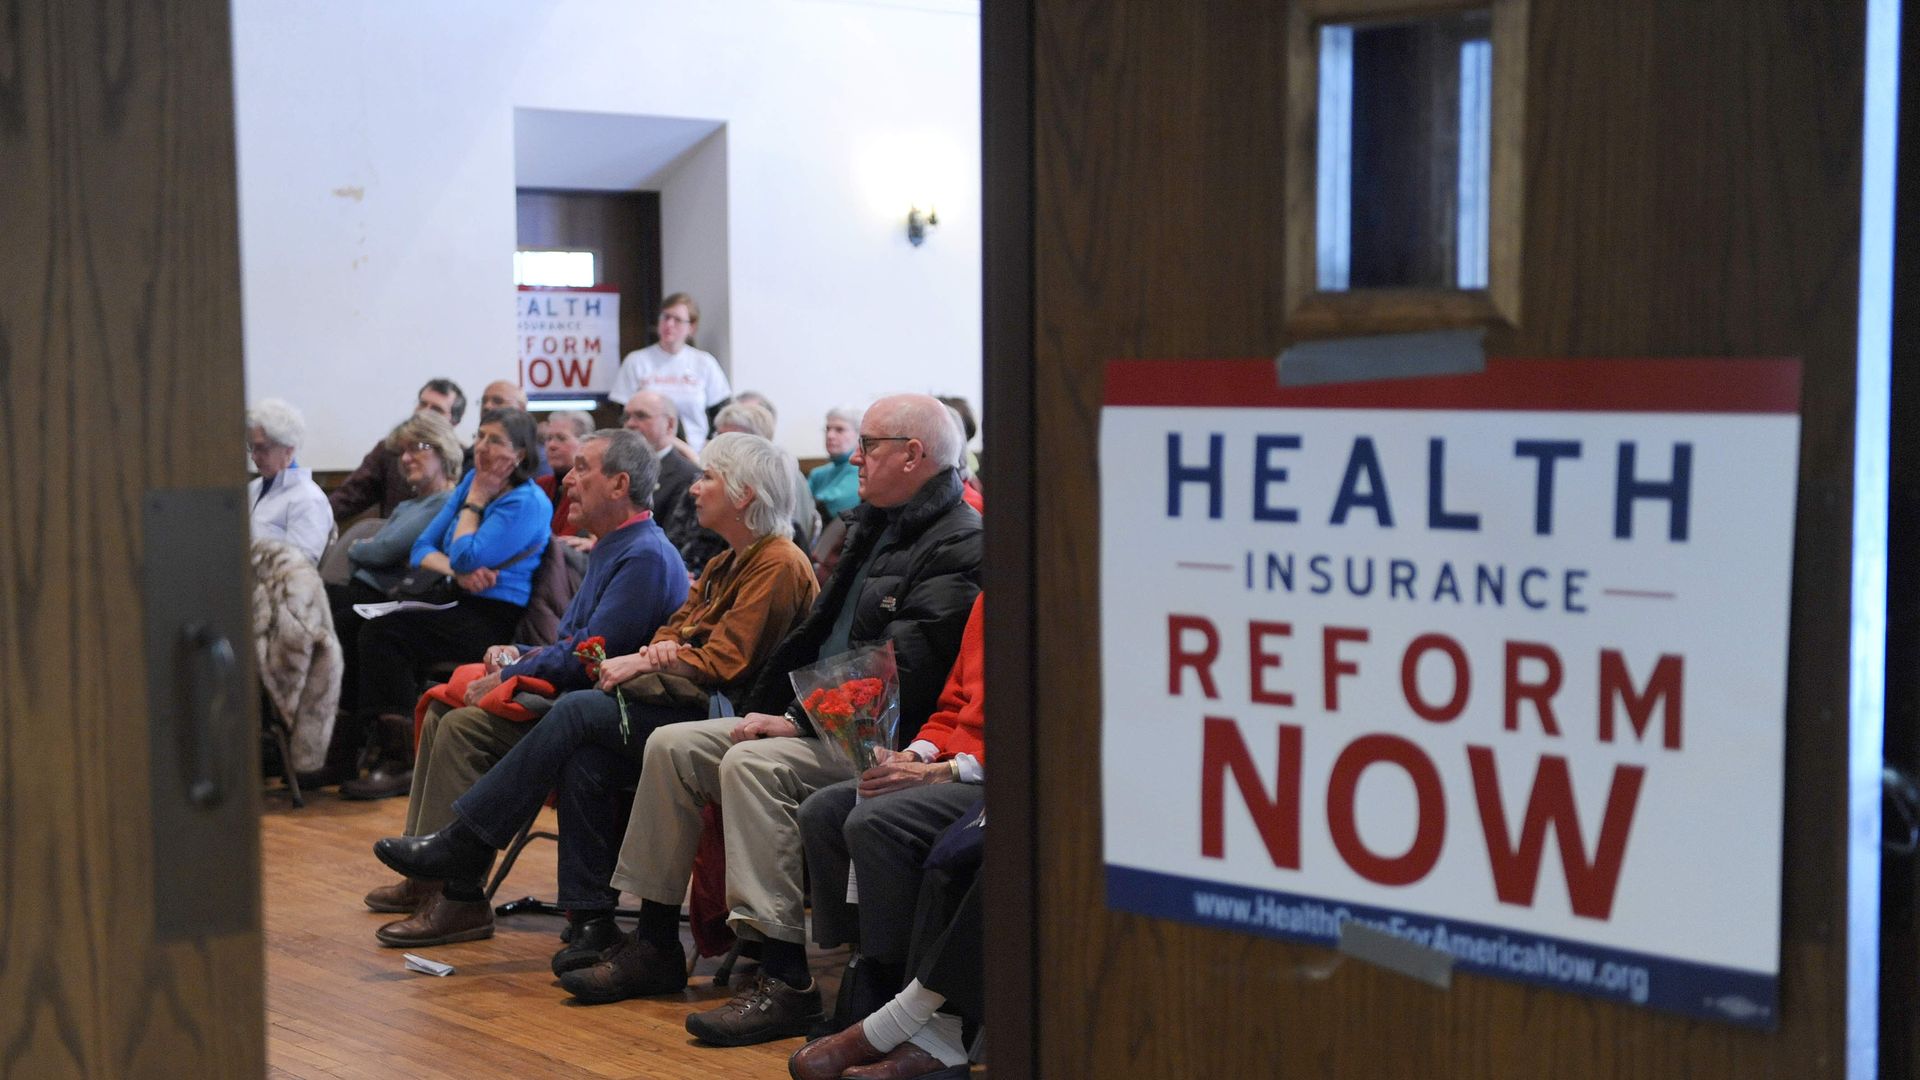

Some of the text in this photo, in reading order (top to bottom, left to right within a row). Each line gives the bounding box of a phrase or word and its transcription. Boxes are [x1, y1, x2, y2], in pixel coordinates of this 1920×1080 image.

[518, 336, 601, 354] FORM
[518, 358, 593, 388] OW
[1165, 431, 1693, 543] HEALTH
[1245, 551, 1590, 613] INSURANCE
[1167, 613, 1685, 750] REFORM
[1199, 715, 1646, 922] NOW
[1193, 891, 1650, 1004] www.HealthCForAmericaNow.org
